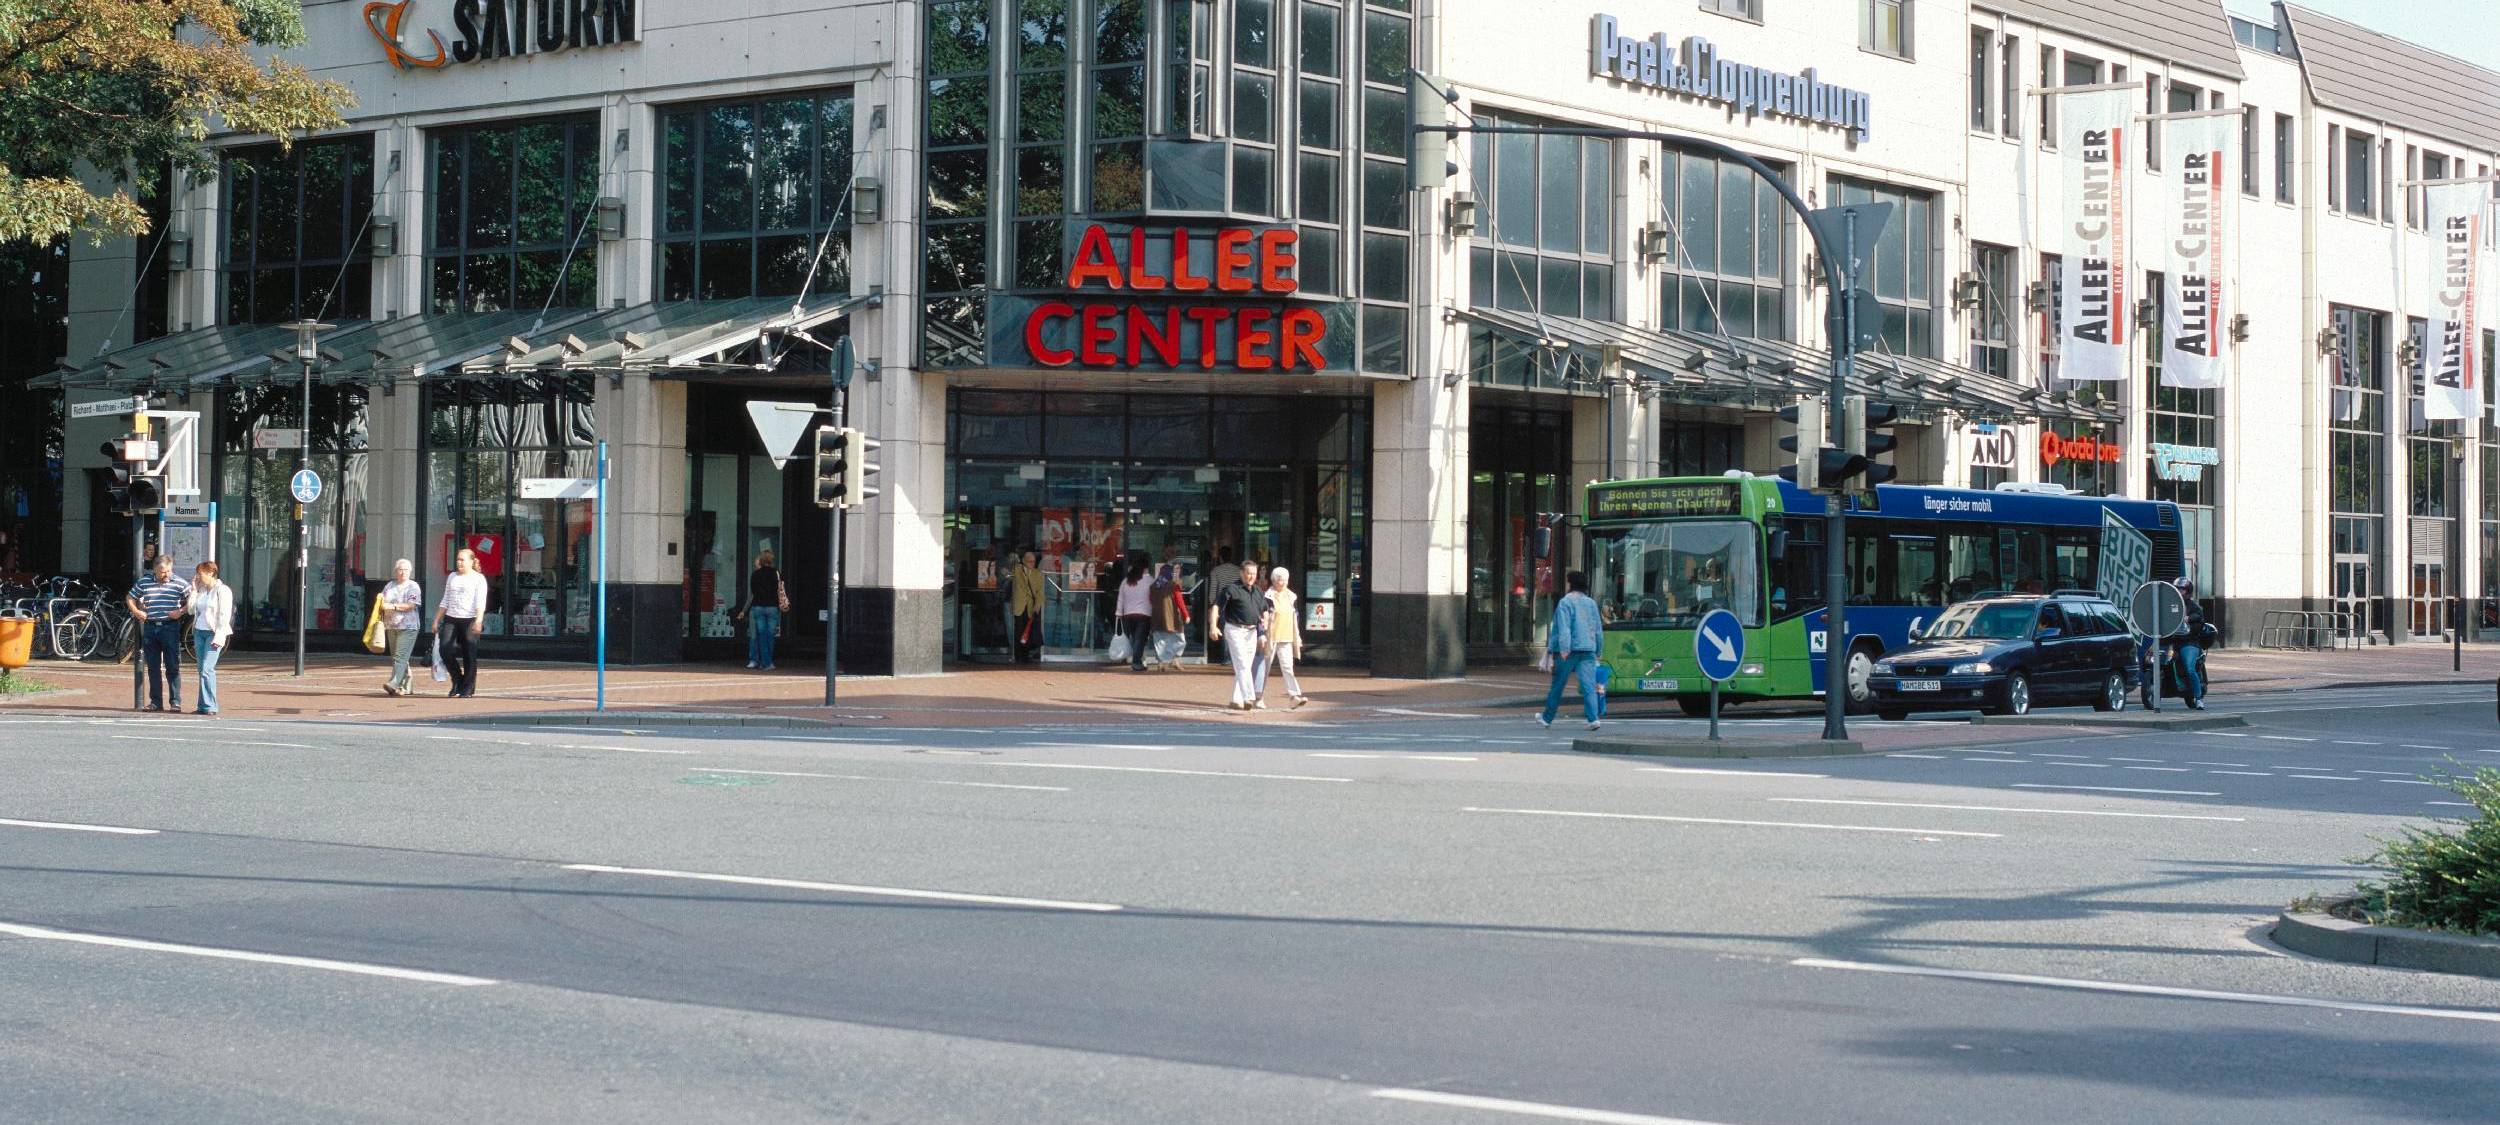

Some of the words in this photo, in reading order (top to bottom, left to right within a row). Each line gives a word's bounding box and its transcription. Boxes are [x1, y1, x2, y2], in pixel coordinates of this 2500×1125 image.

[453, 0, 636, 62] SATURN
[1067, 224, 1298, 292] ALLEE
[1025, 302, 1327, 370] CENTER
[2060, 435, 2121, 462] vodaone
[1923, 495, 1948, 514] länger
[1949, 496, 1970, 511] sicher
[1971, 498, 1992, 513] mobil
[1319, 517, 1337, 570] SATU
[2107, 521, 2146, 578] BUS
